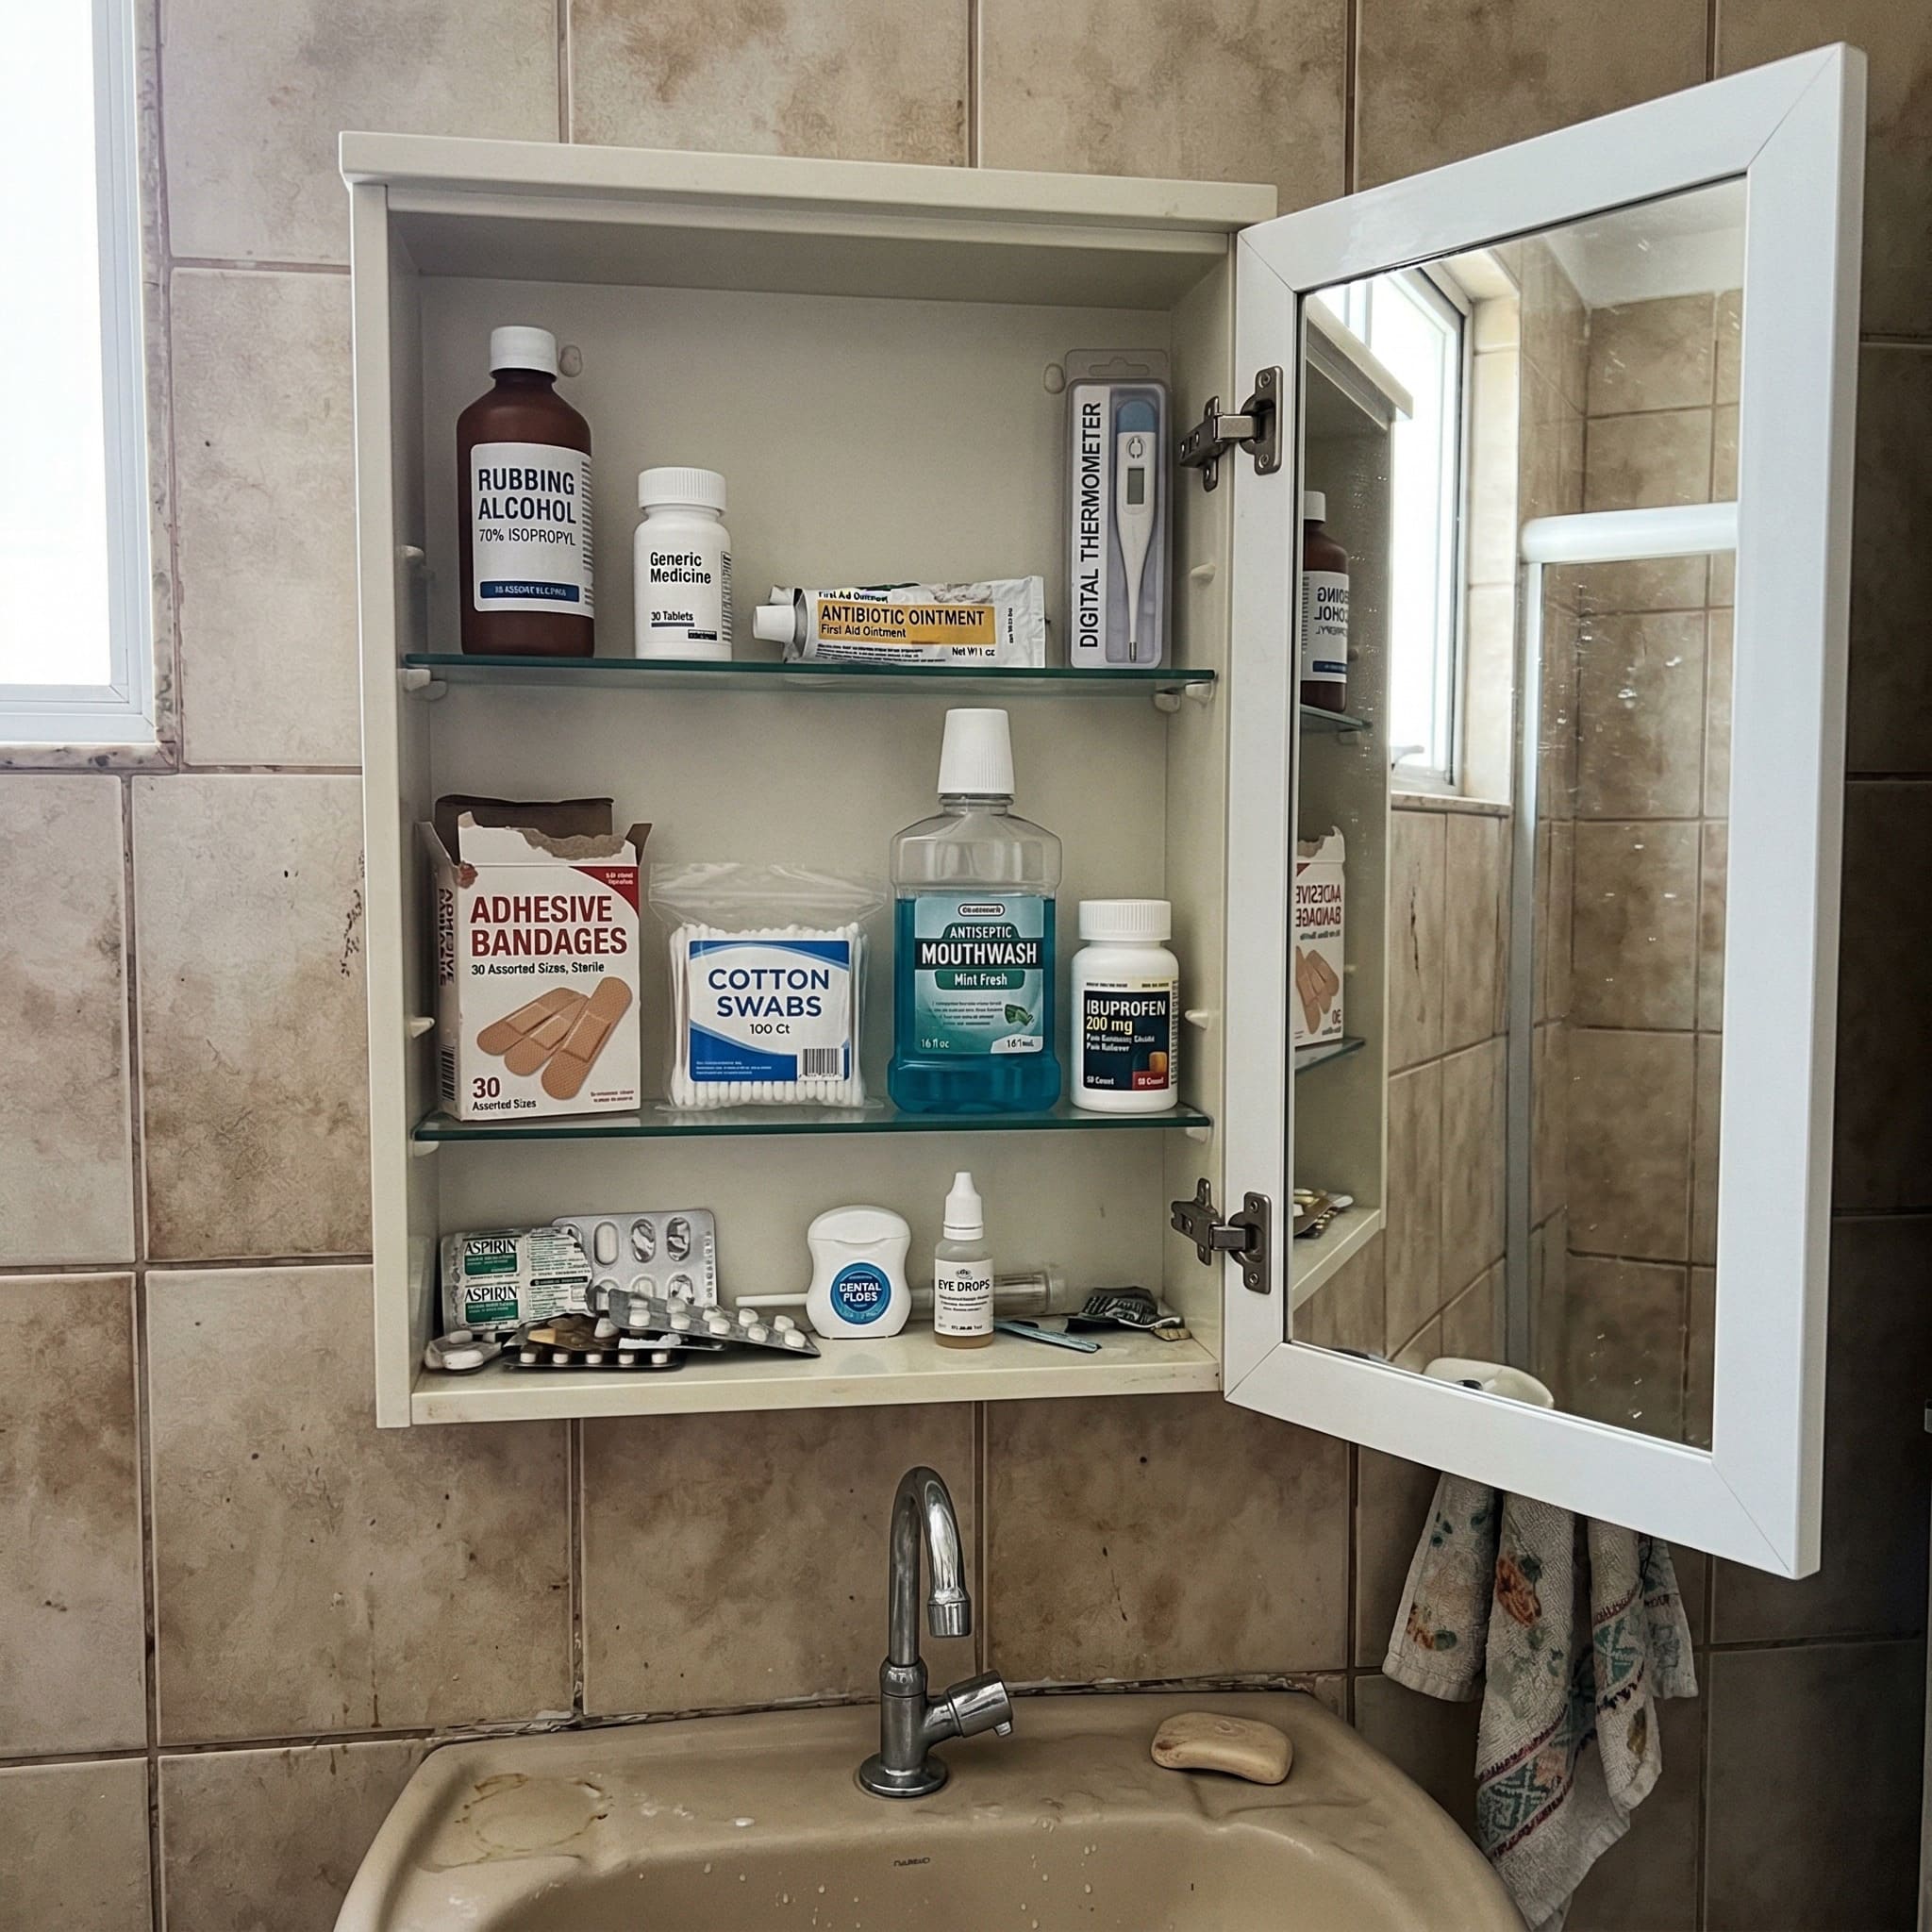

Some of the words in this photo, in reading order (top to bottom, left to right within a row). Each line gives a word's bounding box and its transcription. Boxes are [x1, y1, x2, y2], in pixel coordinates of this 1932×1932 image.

[478, 468, 575, 495] RUBBING
[1081, 402, 1101, 562] THERMOMETER
[478, 496, 576, 525] ALCOHOL
[479, 528, 505, 541] 70%
[508, 528, 576, 546] ISOPROPYL
[650, 551, 703, 567] Generic
[650, 568, 711, 584] Medicine
[651, 611, 660, 621] 30
[662, 610, 693, 621] Tablets
[821, 605, 905, 625] ANTIBIOTIC
[908, 609, 985, 626] OINTMENT
[1079, 569, 1099, 648] DIGITAL
[863, 625, 906, 638] Ointment
[470, 895, 613, 924] ADHESIVE
[471, 927, 627, 957] BANDAGES
[950, 926, 1012, 940] ANTISEPTIC
[922, 942, 1037, 965] MOUTHWASH
[472, 964, 485, 975] 30
[488, 963, 535, 974] Assorted
[571, 961, 605, 974] Sterile
[708, 968, 830, 991] COTTON
[954, 974, 977, 986] Mint
[980, 973, 1008, 986] Fresh
[716, 995, 823, 1018] SWABS
[1087, 999, 1166, 1016] IBUPROFEN
[749, 1024, 772, 1034] 100
[775, 1024, 790, 1034] Ct
[1086, 1016, 1107, 1031] 200
[1111, 1020, 1133, 1035] mg
[472, 1076, 501, 1099] 30
[464, 1239, 517, 1255] ASPIRIN
[938, 1278, 955, 1291] EYE
[957, 1278, 991, 1291] DROPS
[464, 1286, 517, 1302] ASPIRIN
